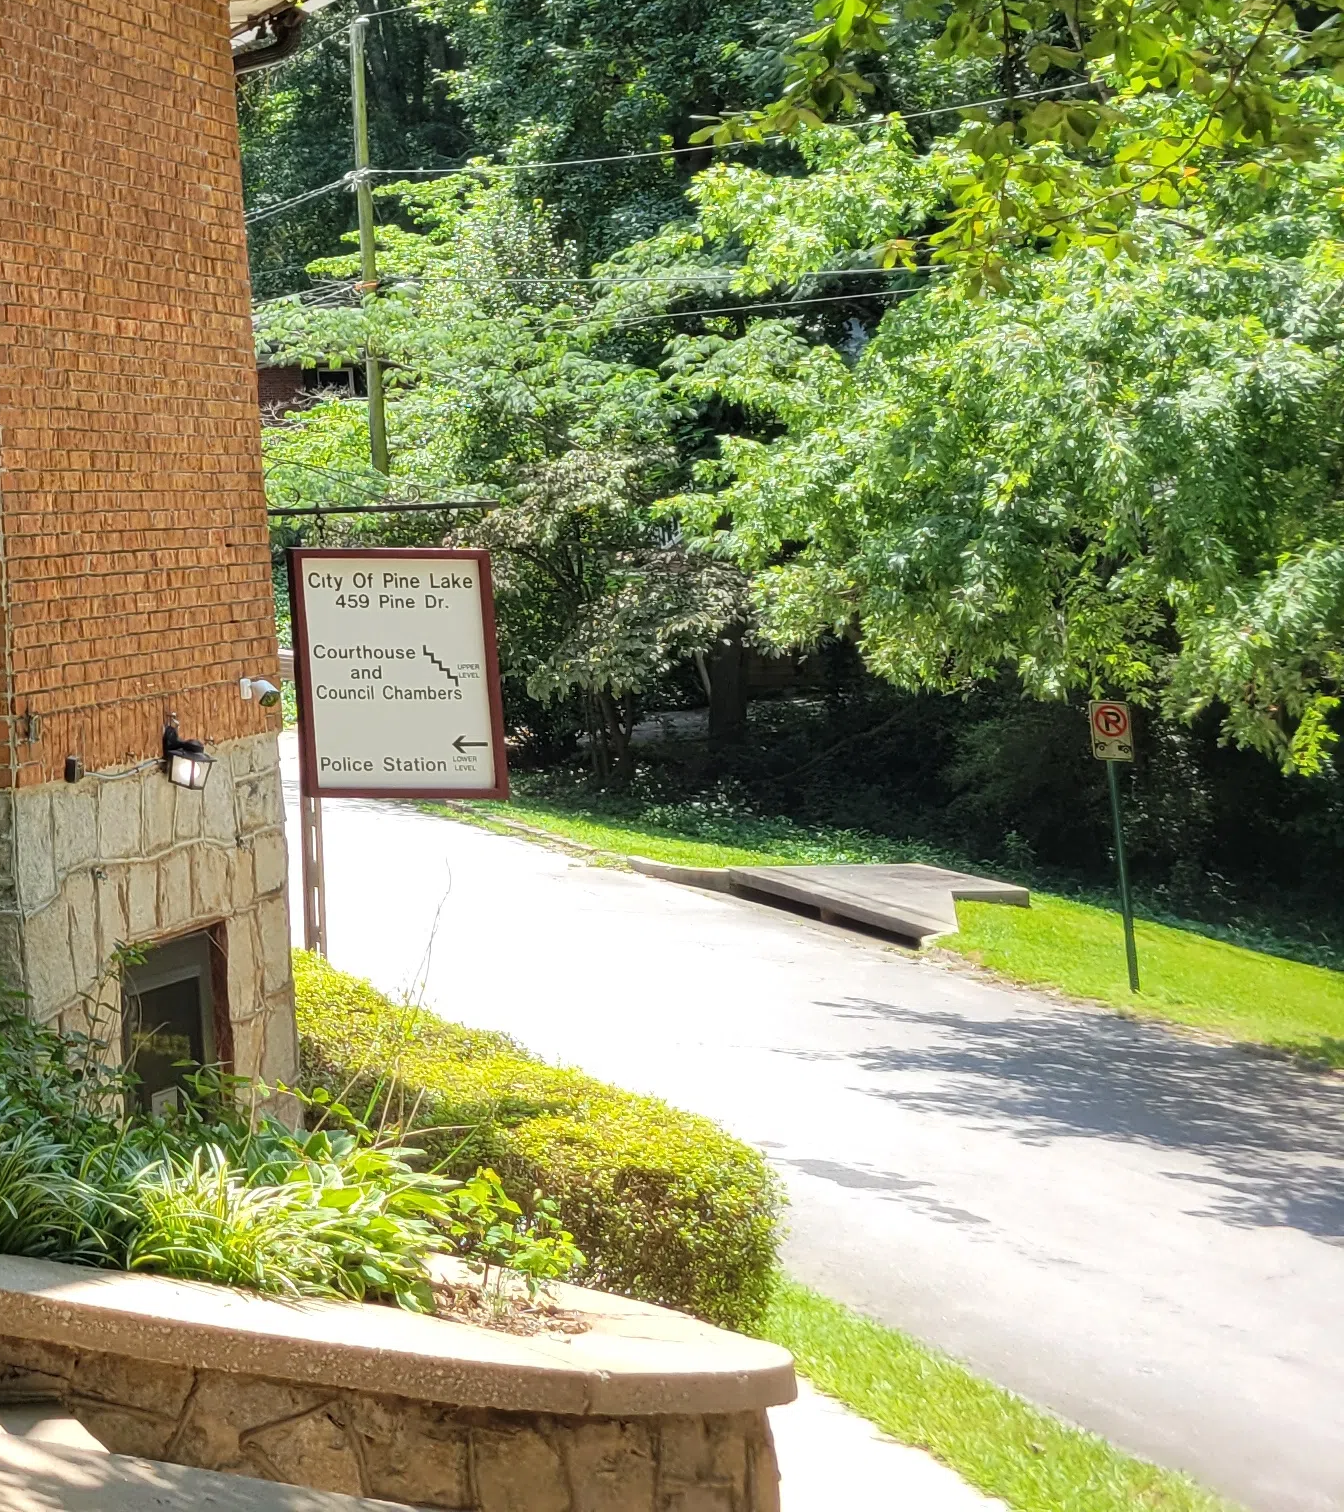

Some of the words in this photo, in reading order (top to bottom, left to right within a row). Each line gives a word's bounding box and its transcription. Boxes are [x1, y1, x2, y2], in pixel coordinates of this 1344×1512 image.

[308, 572, 343, 591] City
[352, 572, 373, 589] Of
[383, 572, 421, 589] Pine
[430, 572, 473, 589] Lake
[335, 594, 370, 609] 459
[379, 595, 416, 609] Pine
[425, 595, 449, 609] Dr.
[313, 644, 416, 660] Courthouse
[350, 665, 383, 680] and
[316, 685, 375, 700] Council
[382, 686, 462, 700] Chambers
[320, 757, 374, 772] Police
[383, 757, 447, 772] Station
